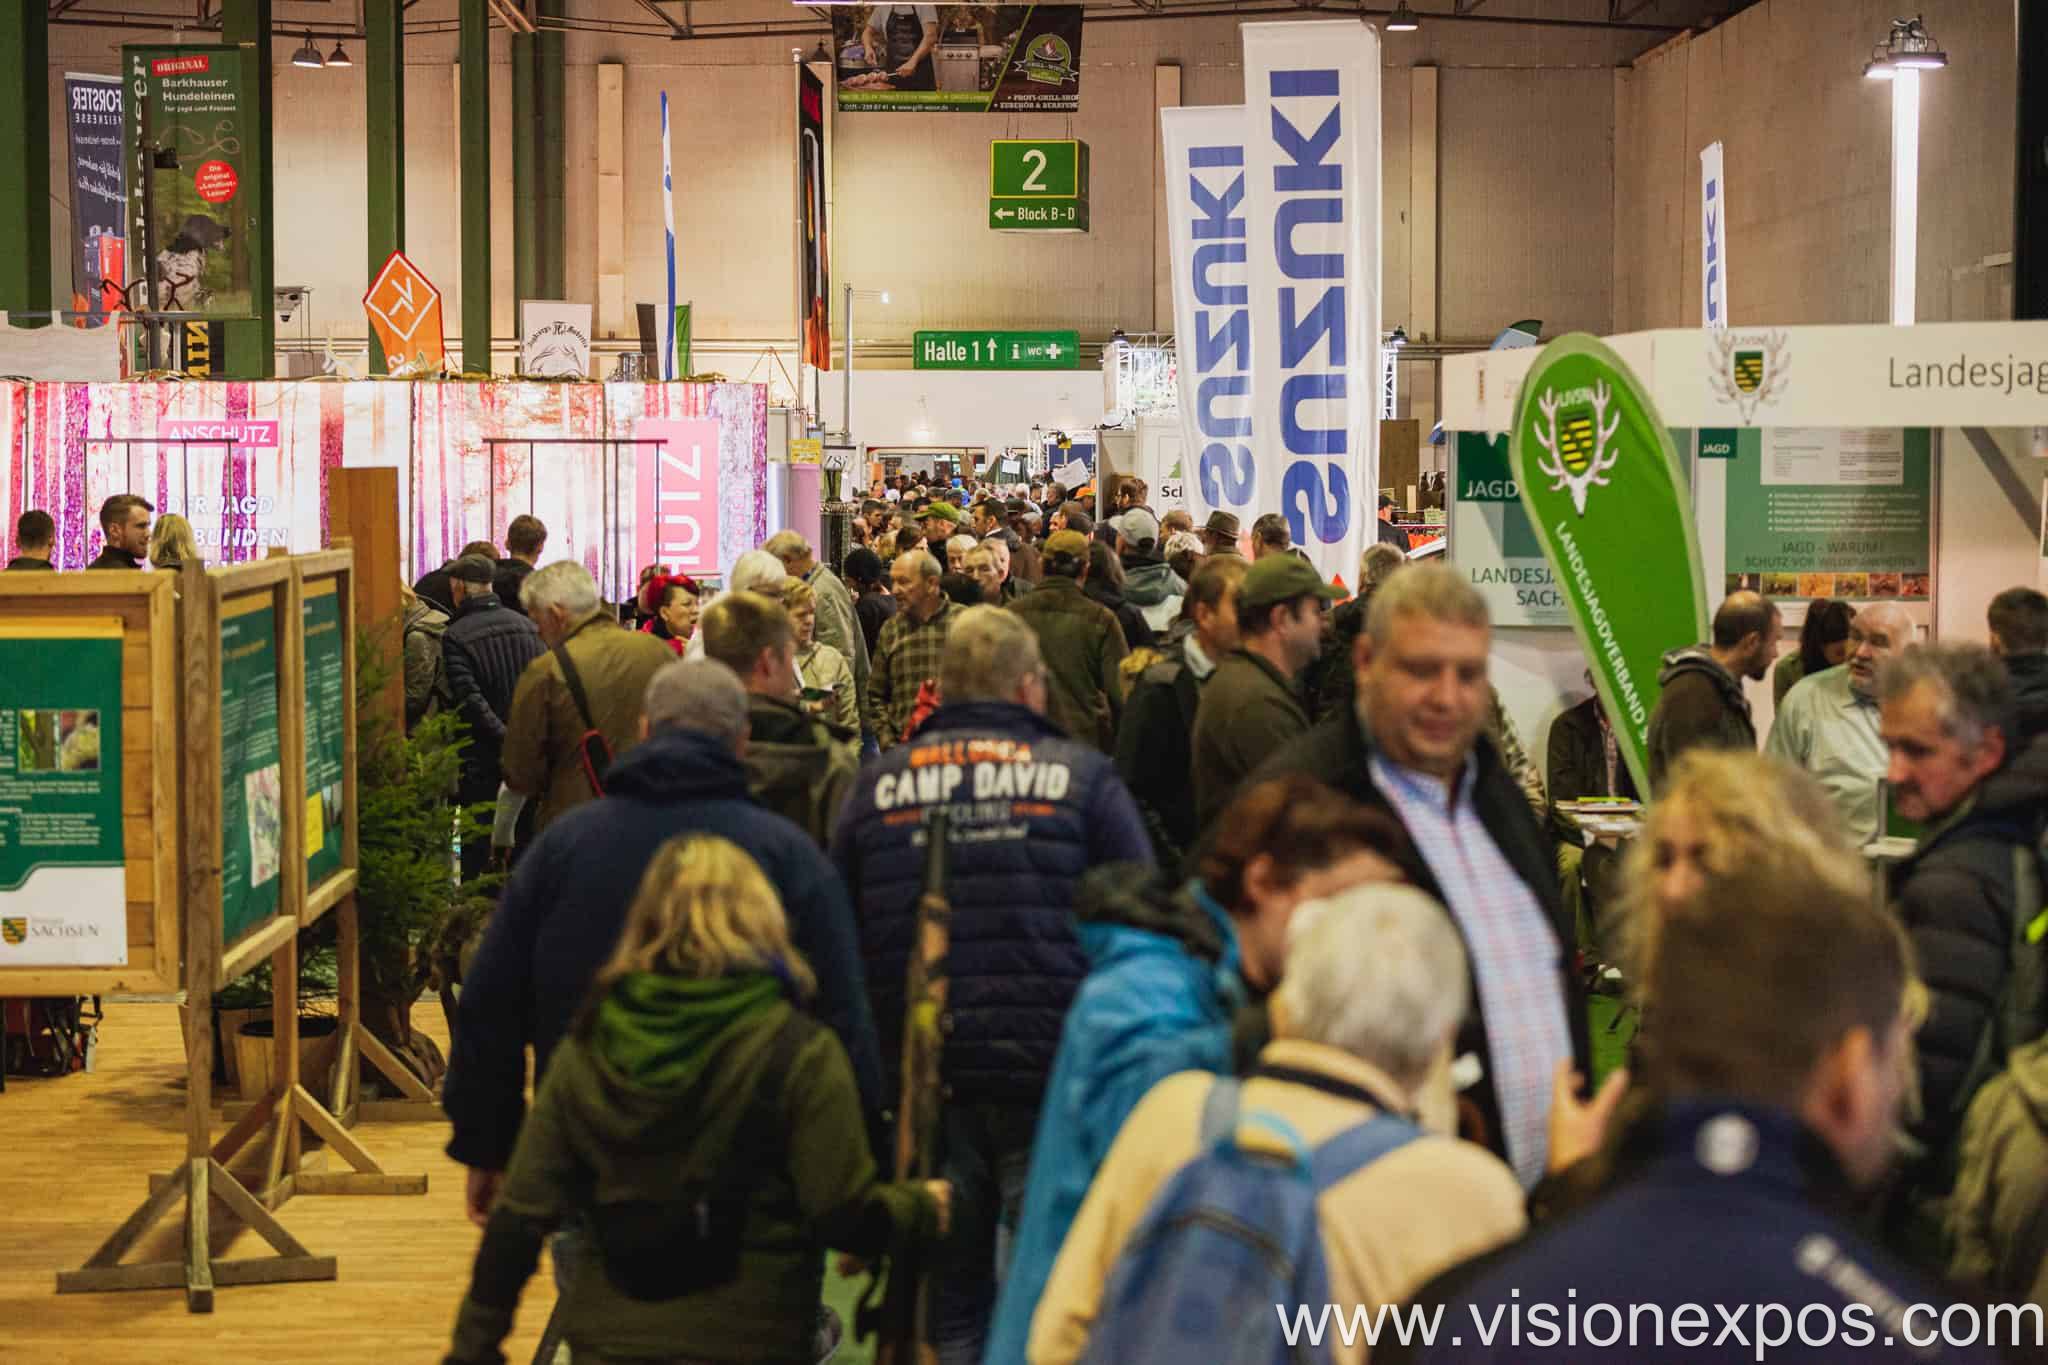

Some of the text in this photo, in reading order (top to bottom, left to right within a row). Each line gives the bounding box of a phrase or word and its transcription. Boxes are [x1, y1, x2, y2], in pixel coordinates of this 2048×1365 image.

[157, 59, 206, 72] ORIGINAL
[162, 78, 228, 88] Barkhauser
[163, 91, 235, 101] Hundeleinen
[1022, 149, 1047, 191] 2
[1018, 207, 1048, 220] Block
[924, 340, 967, 361] Halle
[972, 341, 980, 361] 1
[217, 495, 274, 515] JAGD
[193, 527, 289, 547] BUNDEN
[1471, 567, 1555, 584] LANDESJ
[1555, 520, 1646, 726] LANDESJAGDVERBAND
[874, 761, 1071, 810] CAMP DAVID
